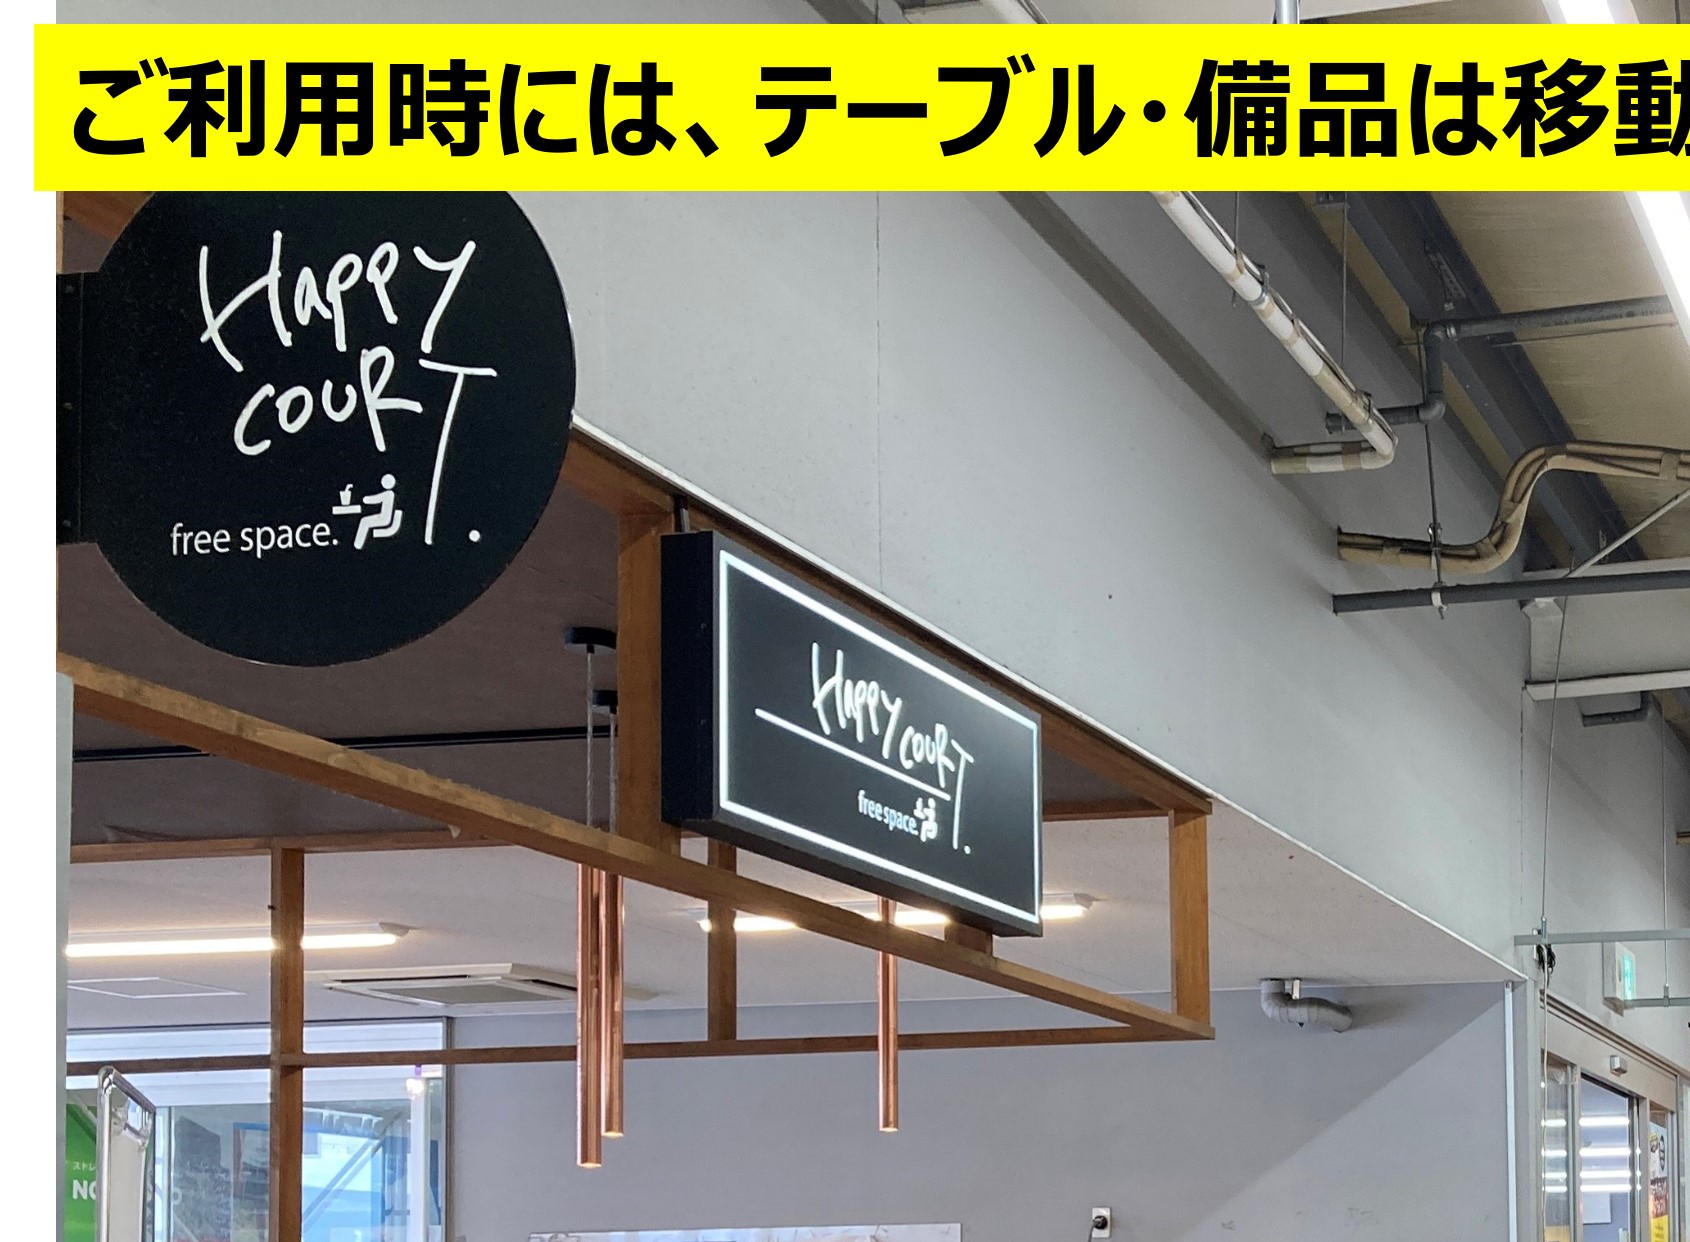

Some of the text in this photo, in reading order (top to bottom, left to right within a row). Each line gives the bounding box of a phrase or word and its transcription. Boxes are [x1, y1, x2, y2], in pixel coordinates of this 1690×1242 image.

[200, 231, 477, 371] Happy
[171, 519, 339, 559] free space.
[811, 642, 903, 759] Happy
[857, 790, 918, 833] free space.
